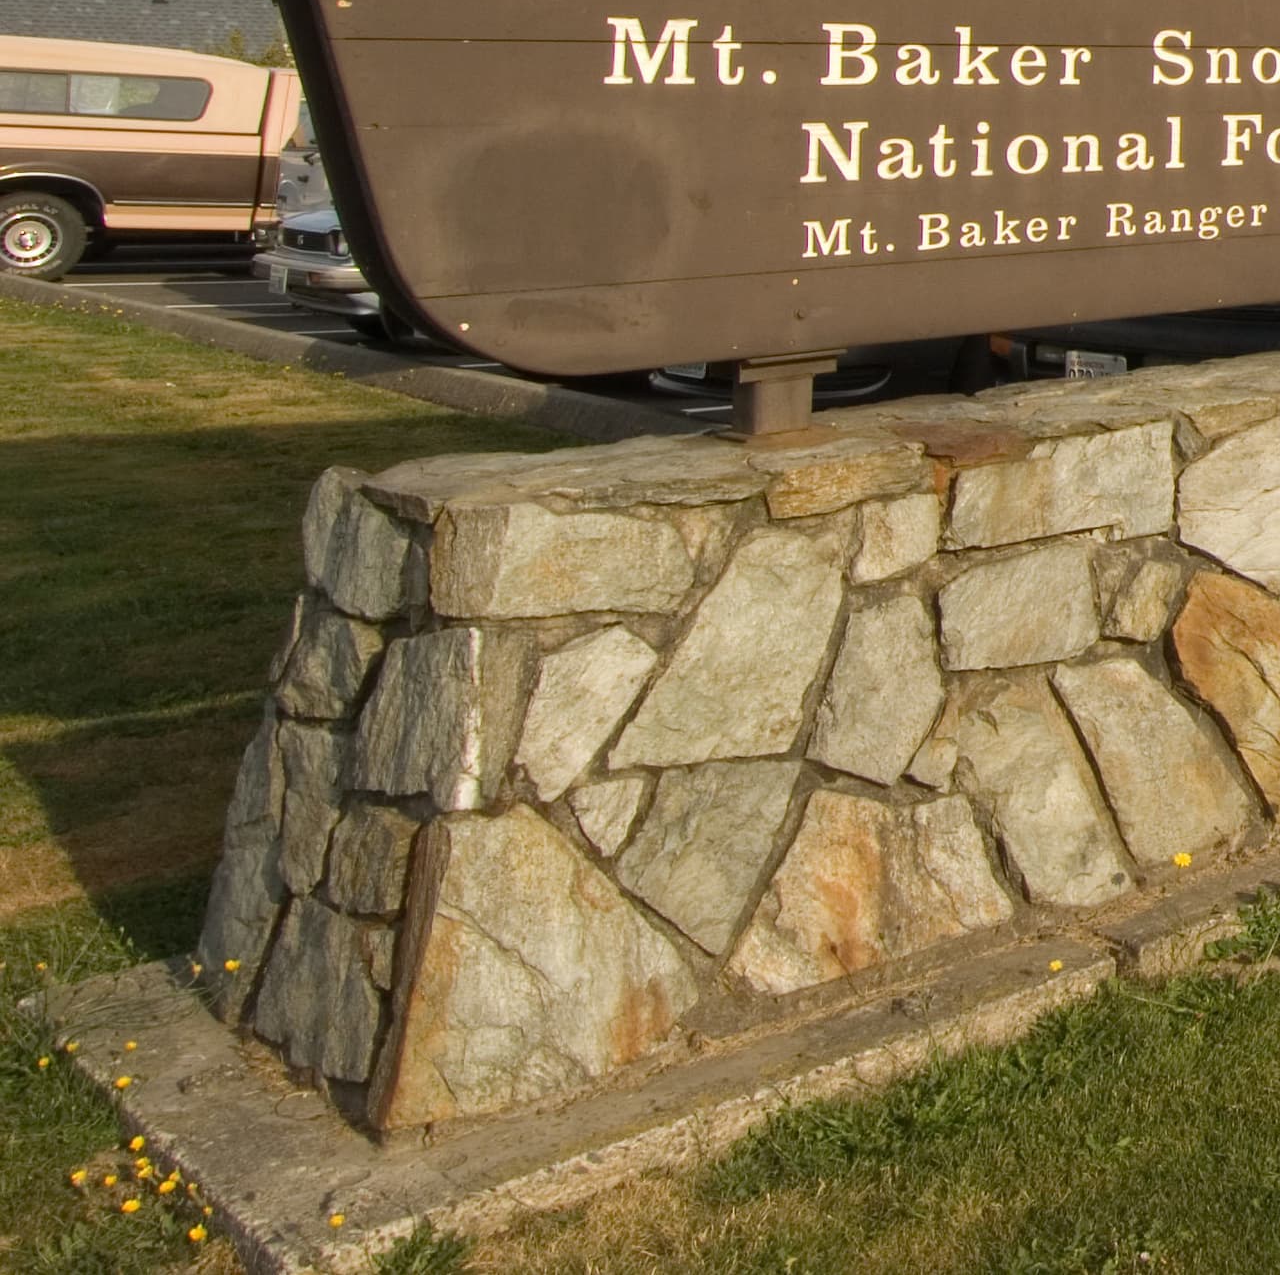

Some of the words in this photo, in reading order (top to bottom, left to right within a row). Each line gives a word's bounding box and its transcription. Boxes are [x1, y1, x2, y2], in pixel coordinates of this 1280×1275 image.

[603, 17, 777, 86] Mt.
[820, 23, 1092, 86] Baker
[799, 116, 1185, 184] National
[801, 218, 895, 258] Mt.
[917, 210, 1077, 251] Baker
[1105, 202, 1268, 240] Ranger
